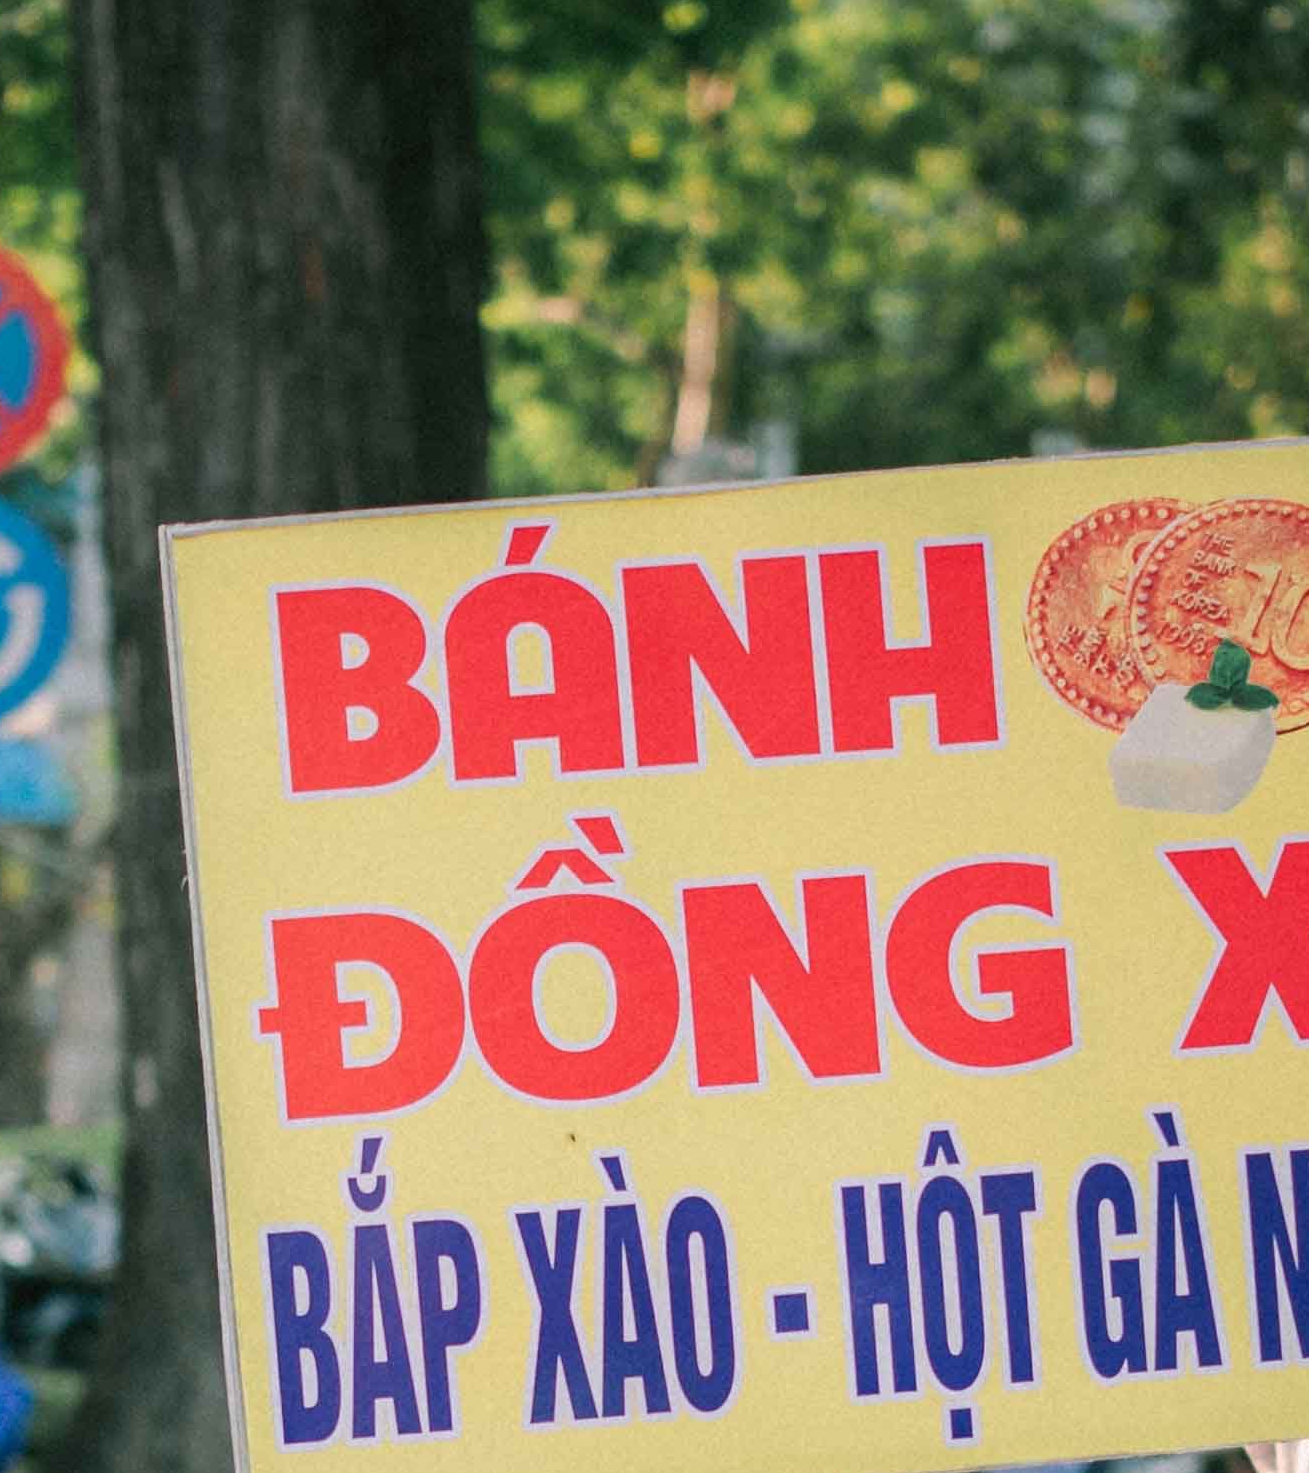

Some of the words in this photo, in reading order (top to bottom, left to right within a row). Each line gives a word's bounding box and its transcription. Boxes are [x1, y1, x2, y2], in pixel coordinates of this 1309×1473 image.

[1170, 589, 1231, 620] KOREA
[1193, 548, 1237, 575] BANK
[1203, 532, 1236, 556] THE
[274, 523, 1001, 794] BÁNH
[257, 814, 1075, 1123] ĐỒNG
[265, 1135, 483, 1447] BẮP
[512, 1154, 736, 1426] XÀO
[840, 1128, 1037, 1440] HỘT
[1075, 1110, 1223, 1381] GÀ
